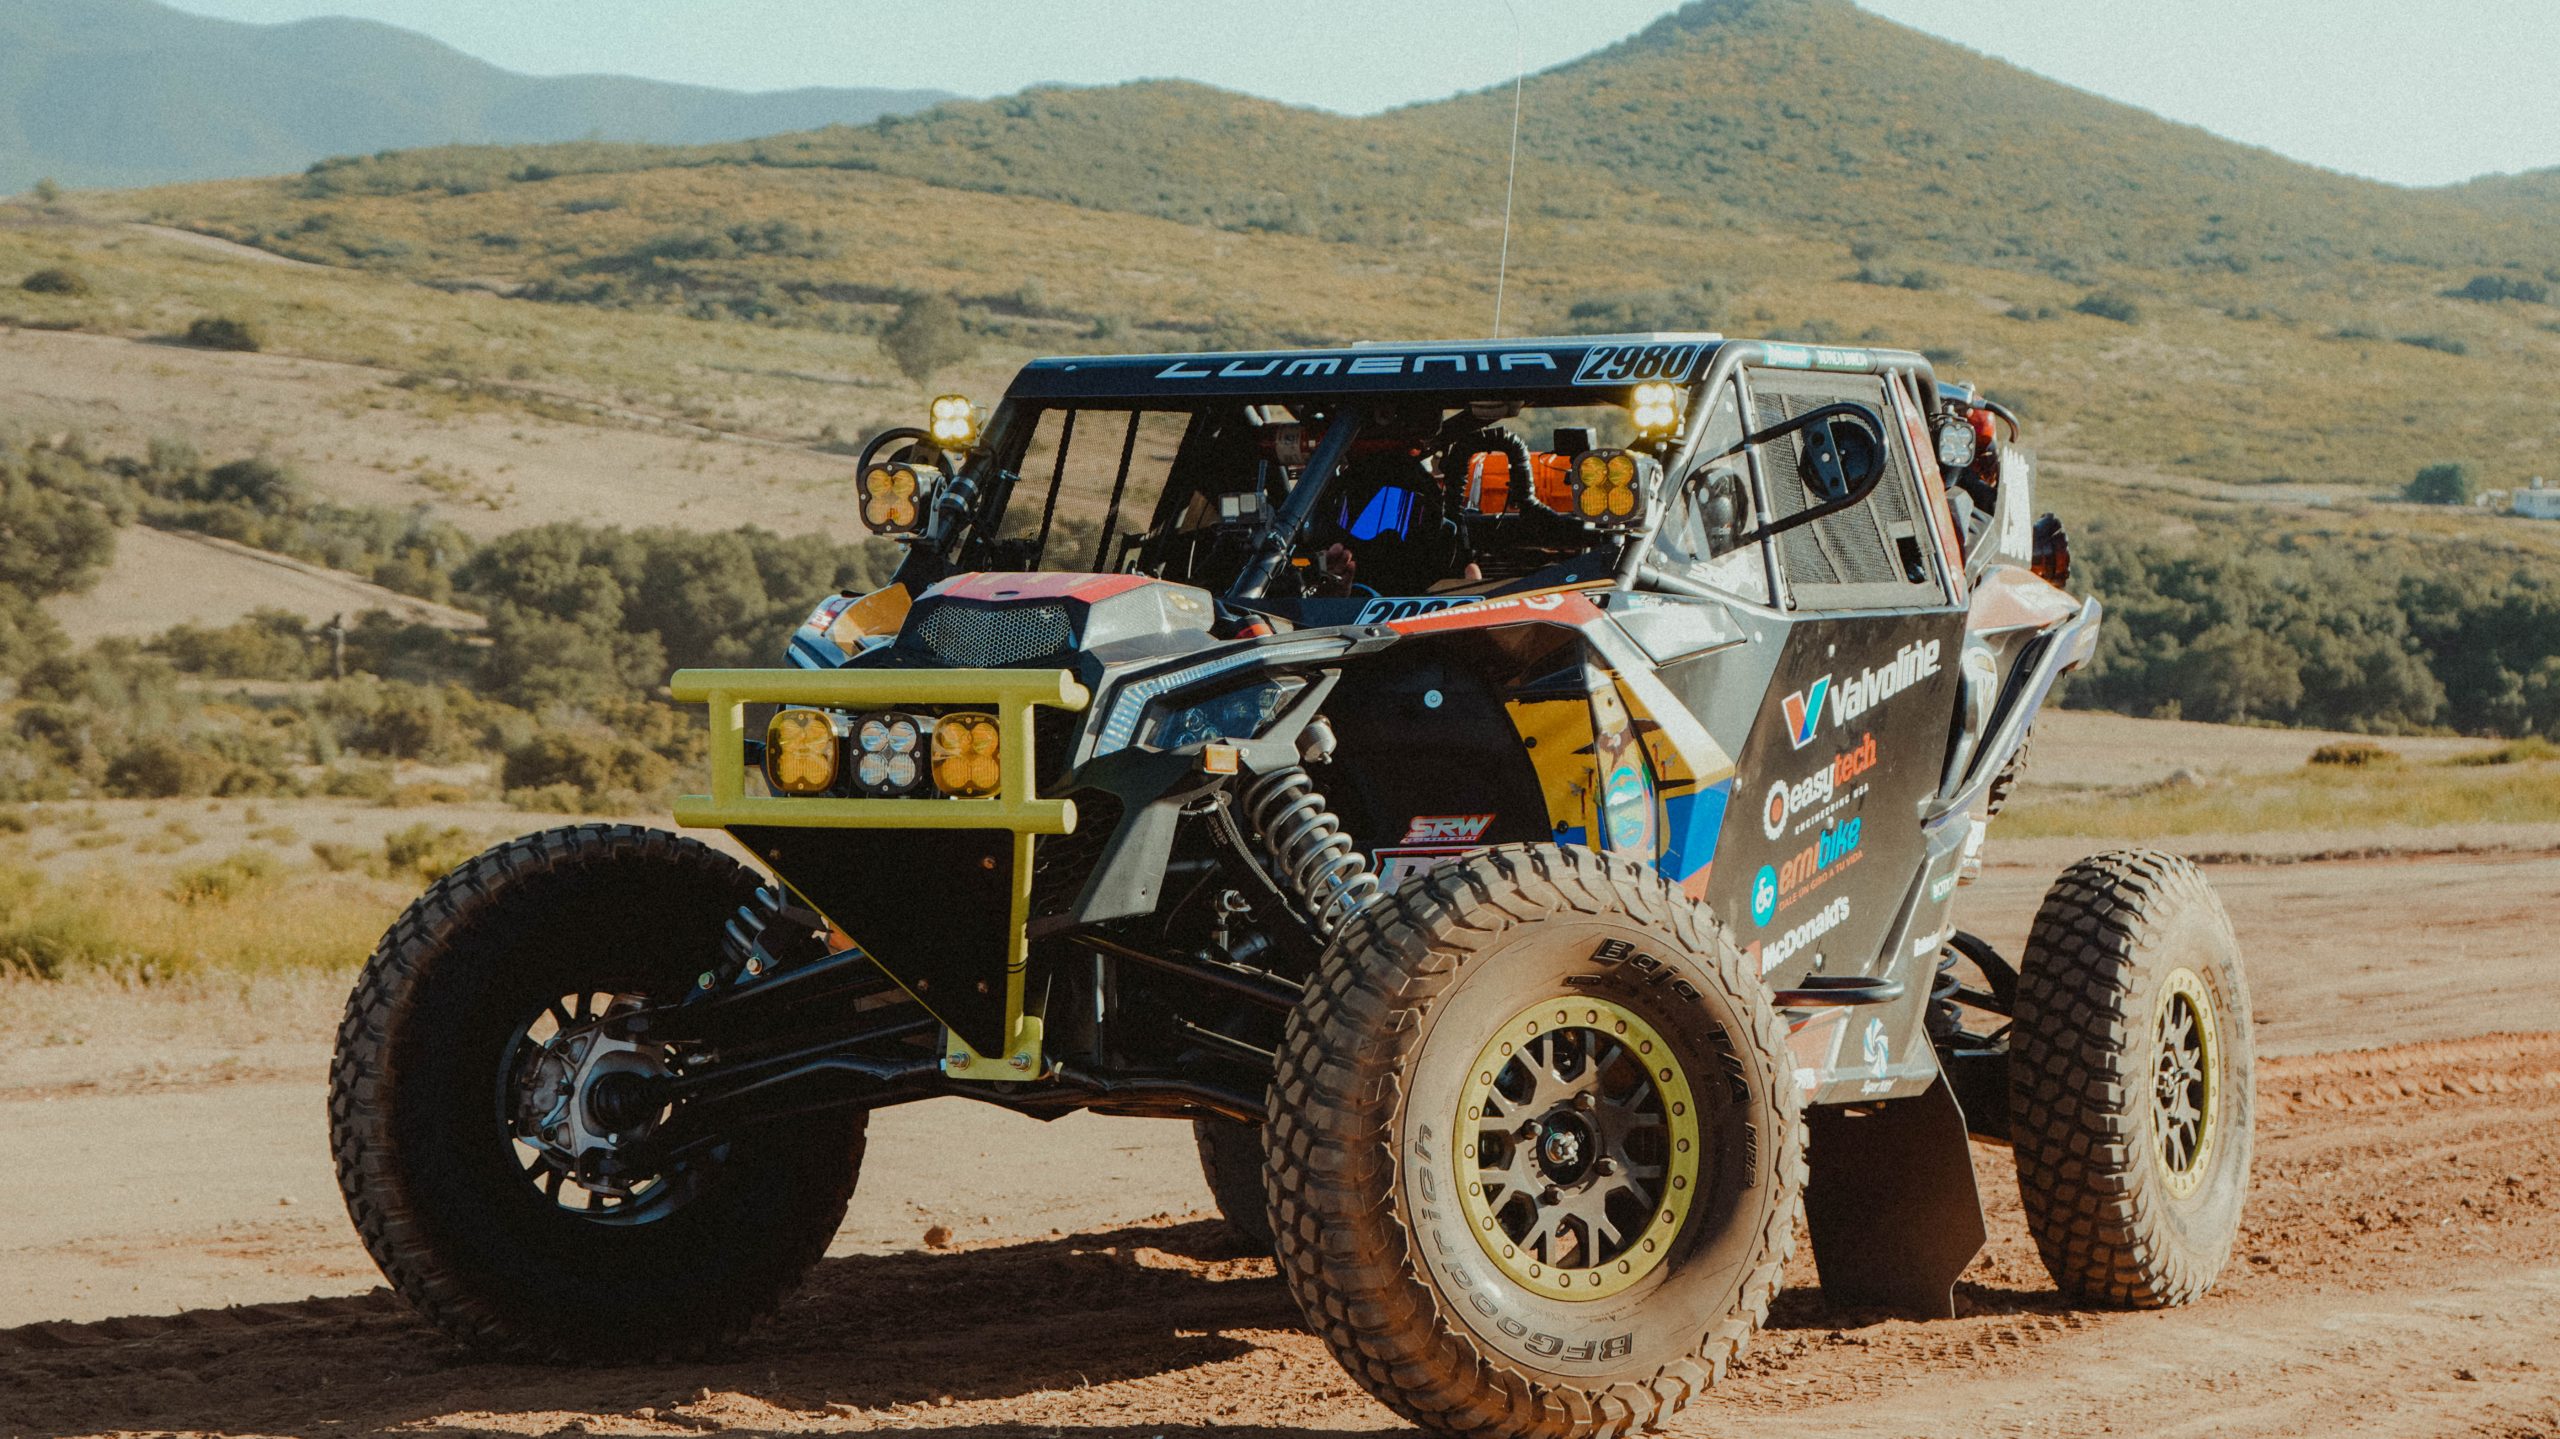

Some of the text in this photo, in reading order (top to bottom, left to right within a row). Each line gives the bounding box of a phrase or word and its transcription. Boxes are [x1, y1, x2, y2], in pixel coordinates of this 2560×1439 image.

[1155, 352, 1557, 378] LUMENIA
[1581, 344, 1687, 379] 2980
[1831, 639, 1941, 727] Valvoline
[1790, 732, 1876, 813] easytech
[1406, 816, 1490, 838] SRW
[1795, 783, 1869, 835] ENGINEERING USA
[1846, 849, 1863, 866] VIDA
[1761, 896, 1849, 975] McDonald's
[1589, 937, 1704, 1002] Baja
[1414, 1123, 1633, 1362] BFGoodrich
